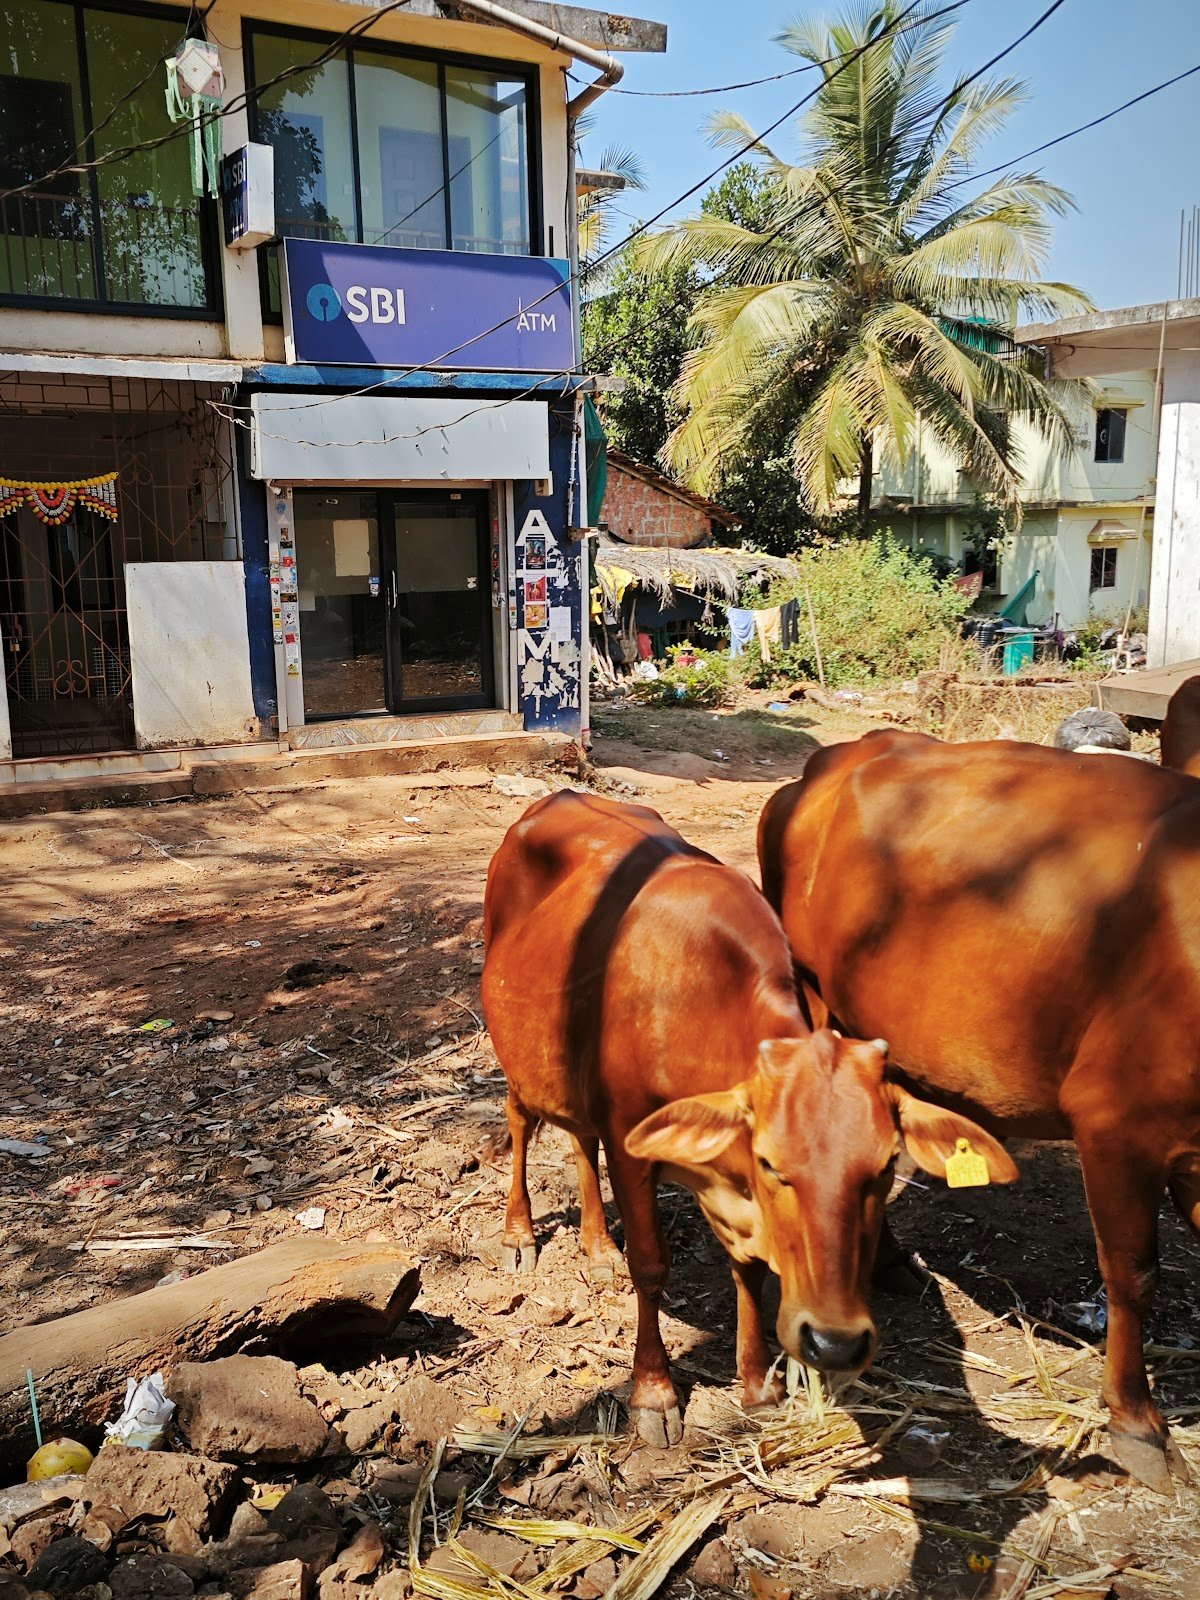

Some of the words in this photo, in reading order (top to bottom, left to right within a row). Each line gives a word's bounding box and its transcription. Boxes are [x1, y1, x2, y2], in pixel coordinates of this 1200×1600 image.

[232, 158, 246, 188] SBI
[346, 285, 406, 325] SBI
[516, 312, 556, 332] ATM
